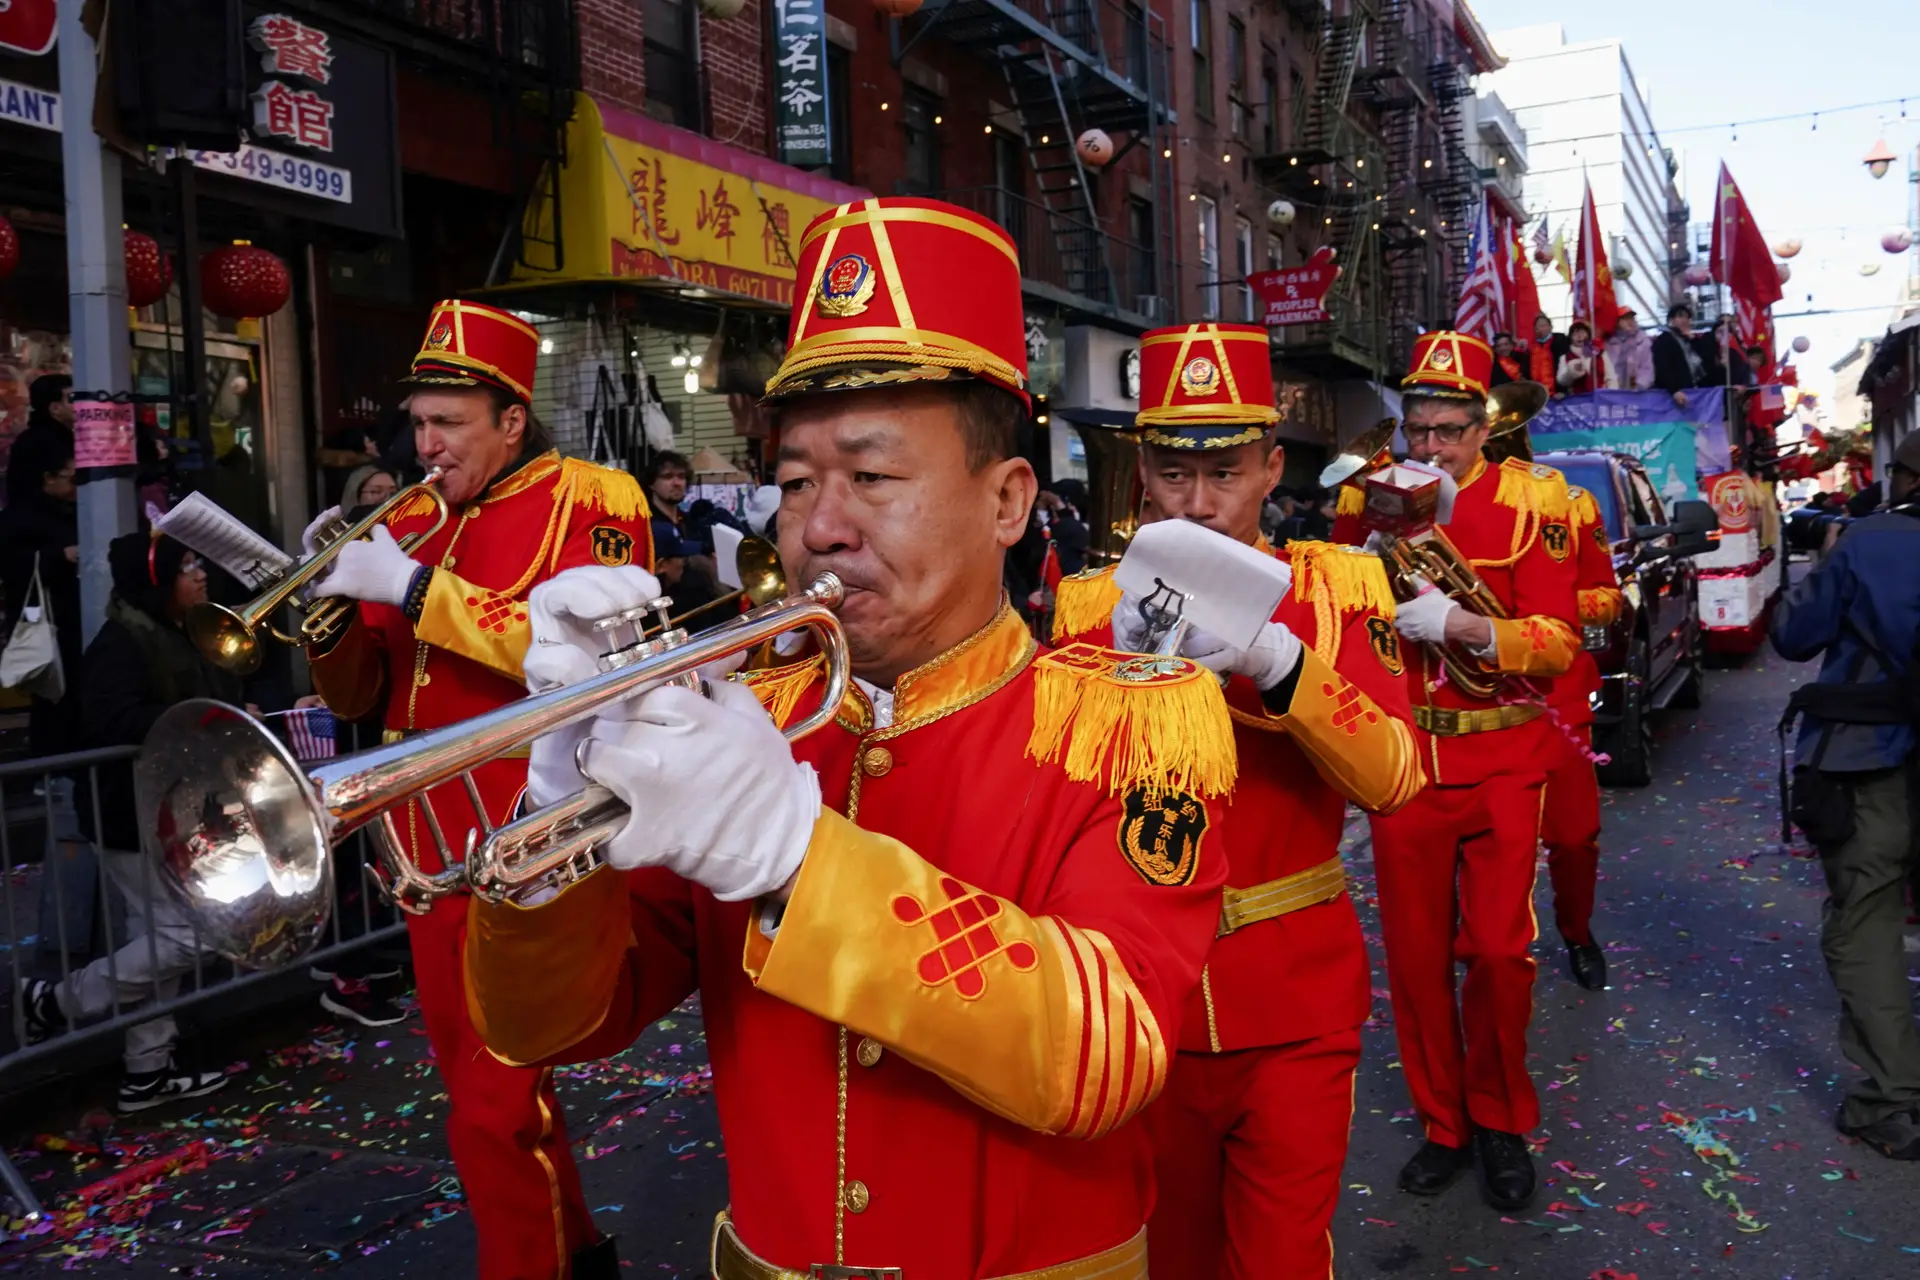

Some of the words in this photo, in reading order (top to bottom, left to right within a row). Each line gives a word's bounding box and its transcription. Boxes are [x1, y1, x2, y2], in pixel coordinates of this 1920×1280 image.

[263, 15, 334, 152] 餐館
[0, 84, 57, 125] ANT
[1265, 310, 1321, 325] PHARMACY
[1271, 298, 1317, 312] PEOPLES
